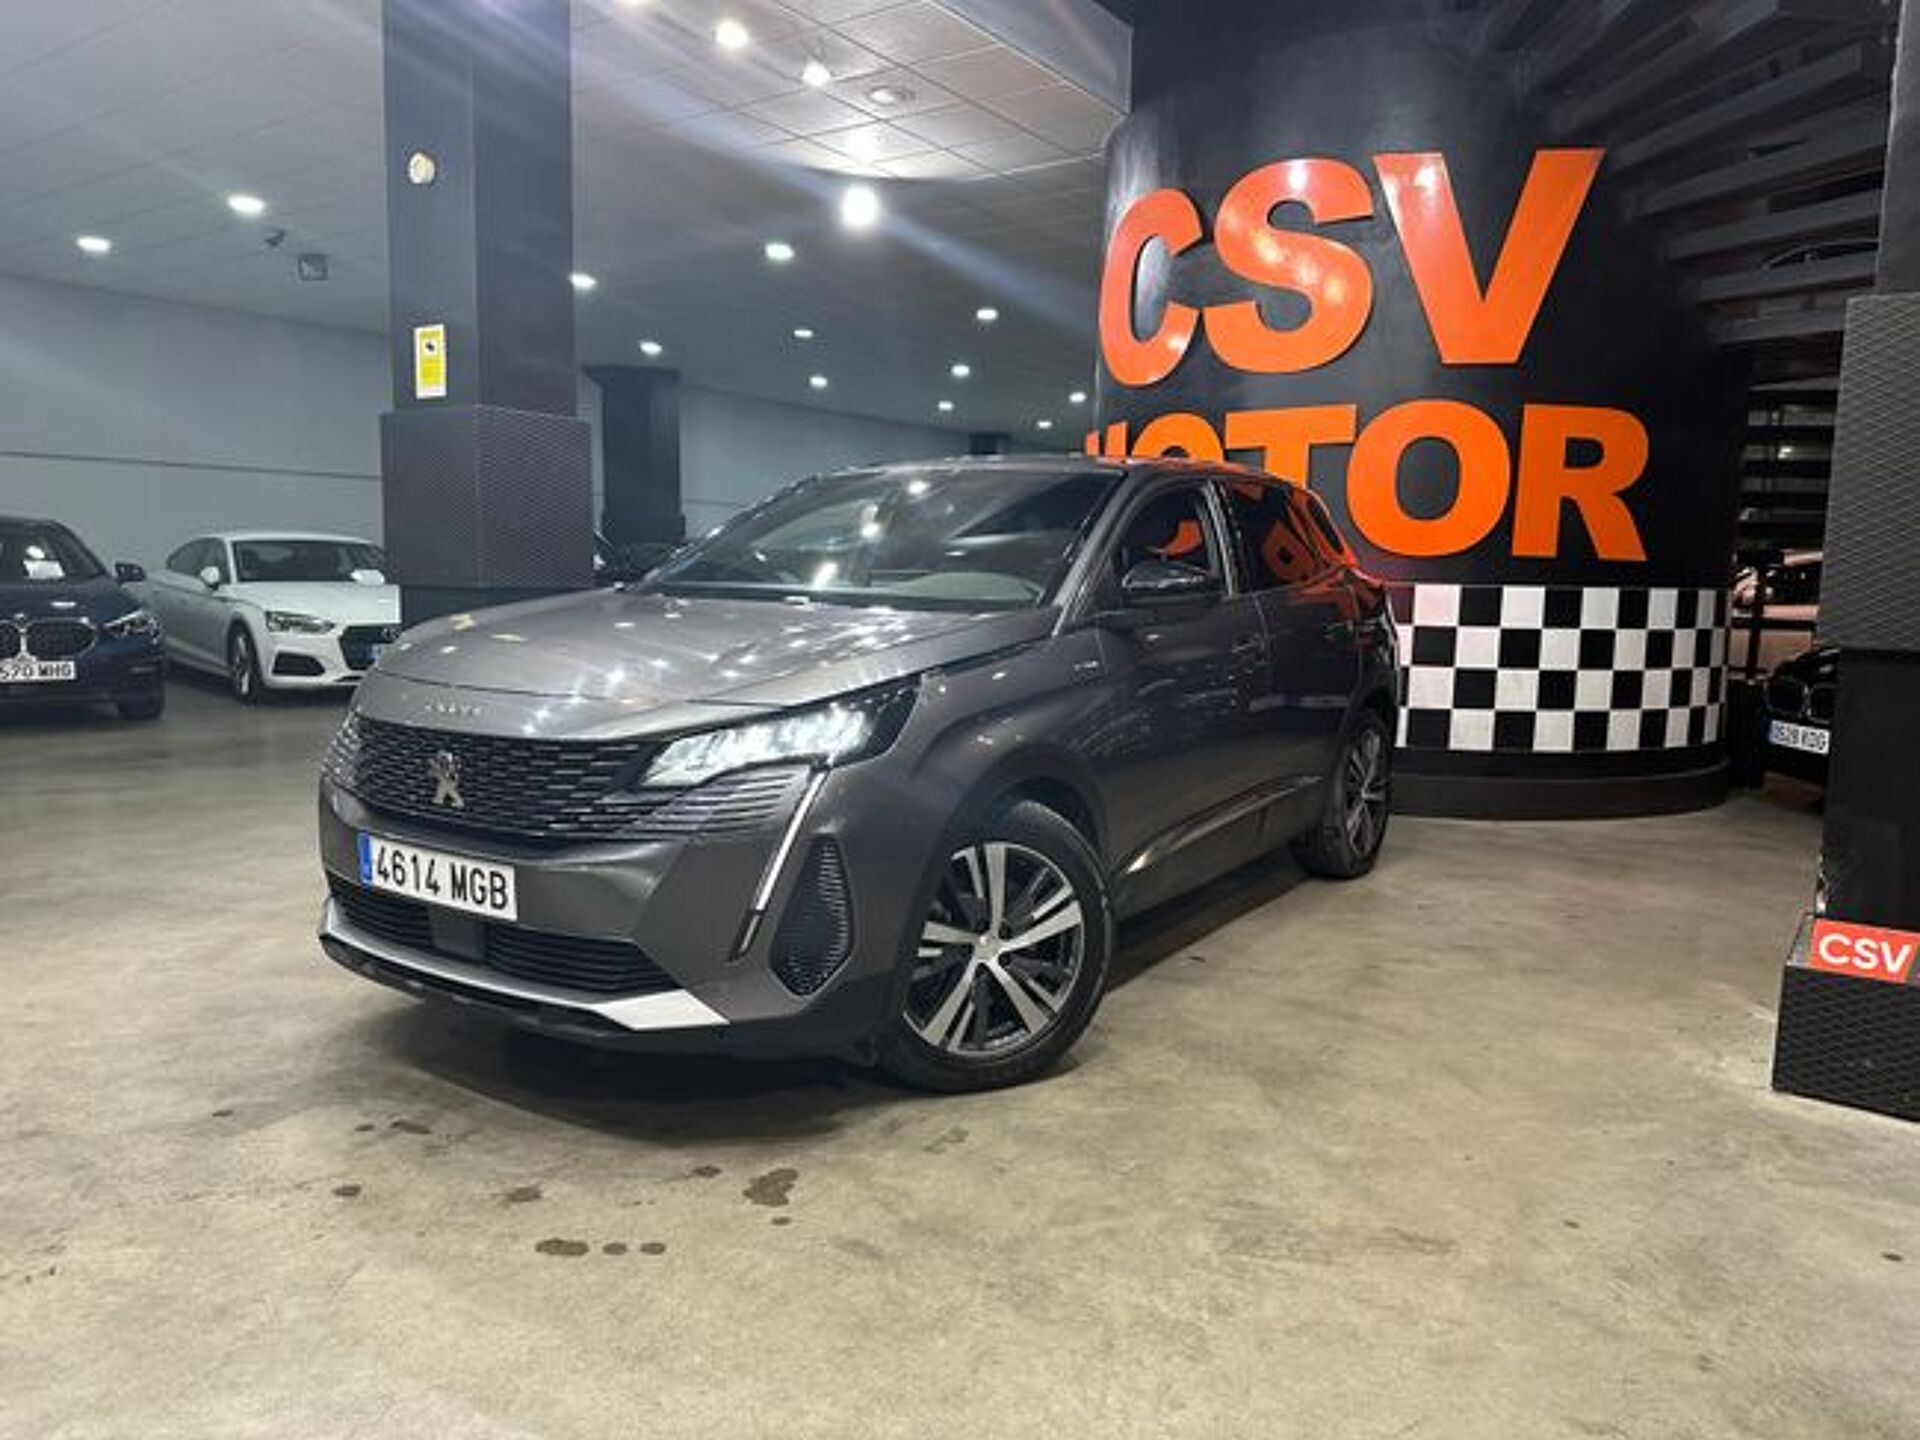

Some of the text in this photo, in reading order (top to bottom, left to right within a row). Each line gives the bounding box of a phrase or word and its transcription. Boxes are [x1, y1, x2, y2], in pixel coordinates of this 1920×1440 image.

[1100, 148, 1605, 386] CSV
[1086, 399, 1650, 562] TOR
[377, 846, 508, 910] 4614 MGB
[1819, 932, 1911, 973] CSV
